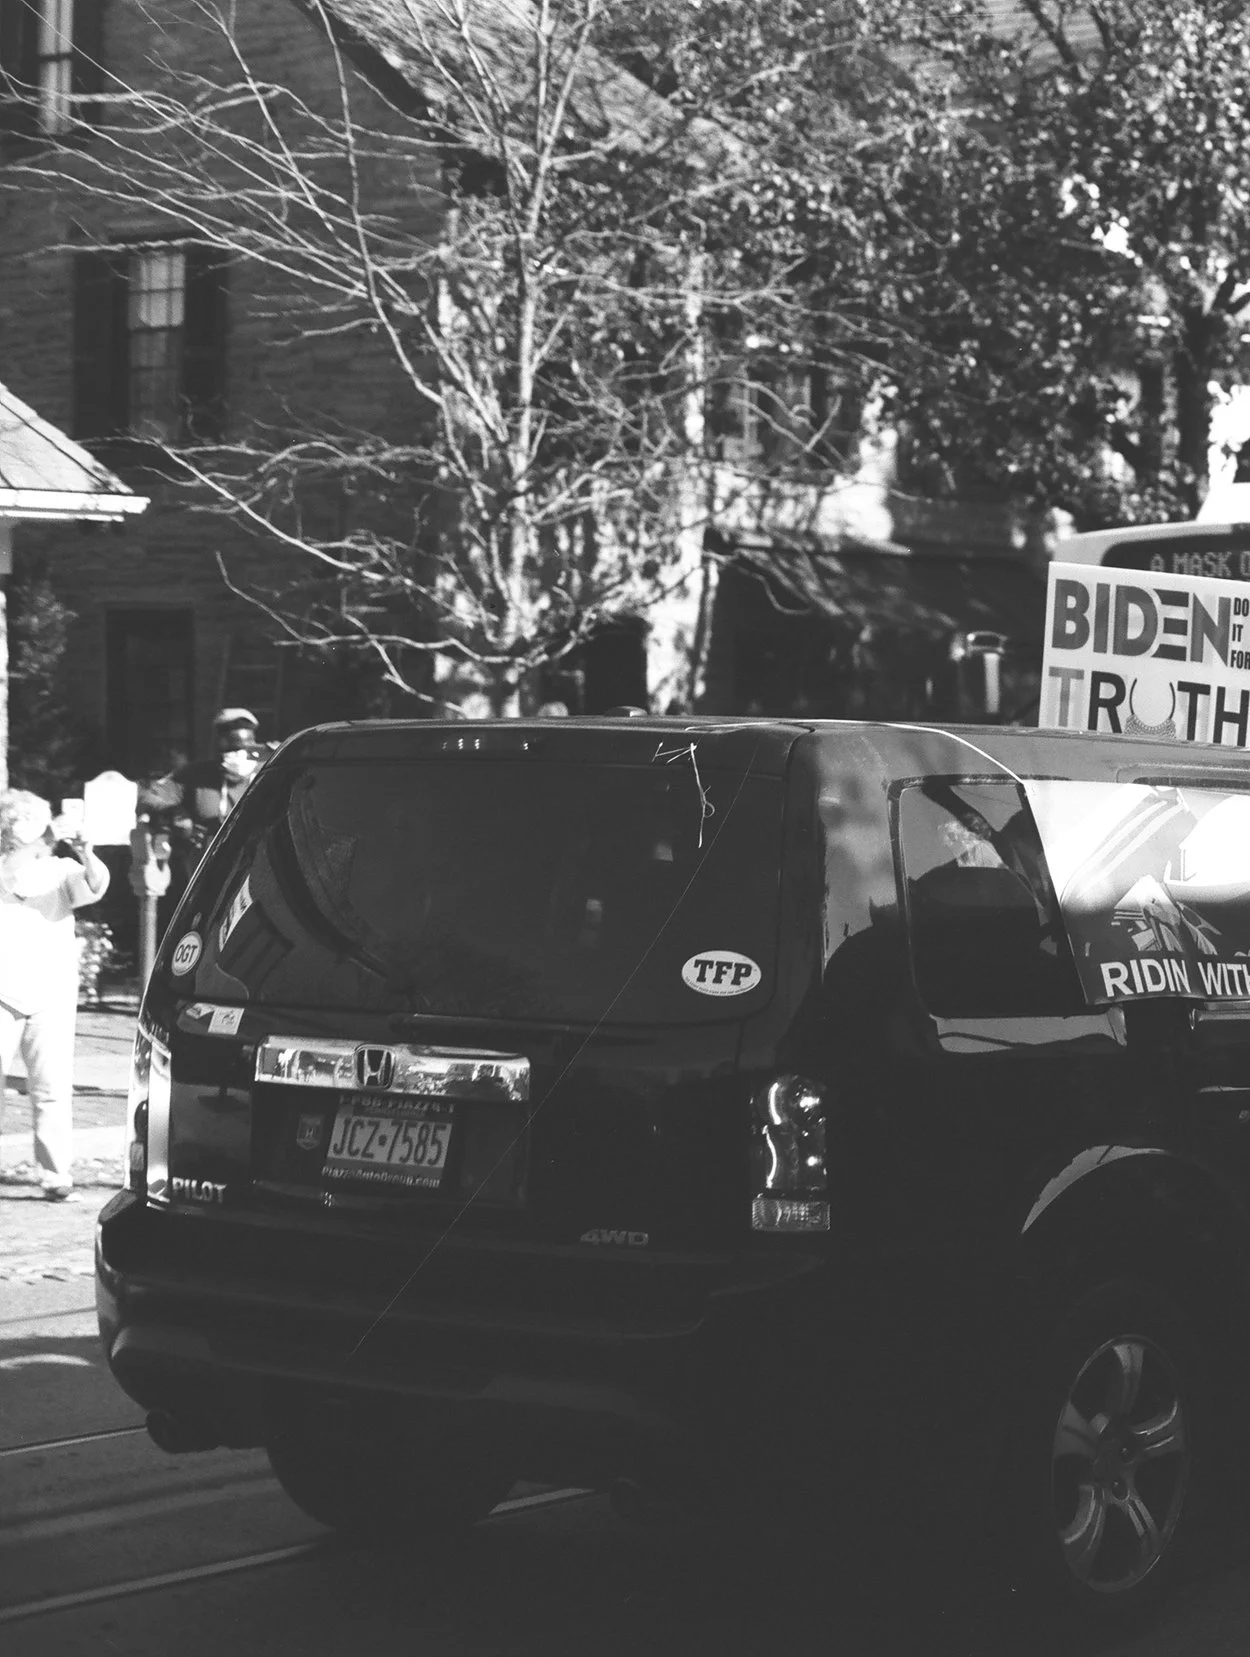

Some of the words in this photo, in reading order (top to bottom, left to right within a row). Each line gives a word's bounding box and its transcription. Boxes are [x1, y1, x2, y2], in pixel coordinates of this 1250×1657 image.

[1150, 554, 1165, 572] A
[1172, 552, 1231, 578] MASK
[1233, 597, 1250, 617] DO
[1051, 578, 1232, 667] BIDEN
[1232, 623, 1244, 642] IT
[174, 943, 199, 963] OGT
[693, 958, 753, 986] TFP
[1100, 958, 1191, 997] RIDIN
[171, 1176, 227, 1203] PILOT
[579, 1228, 650, 1247] 4WD
